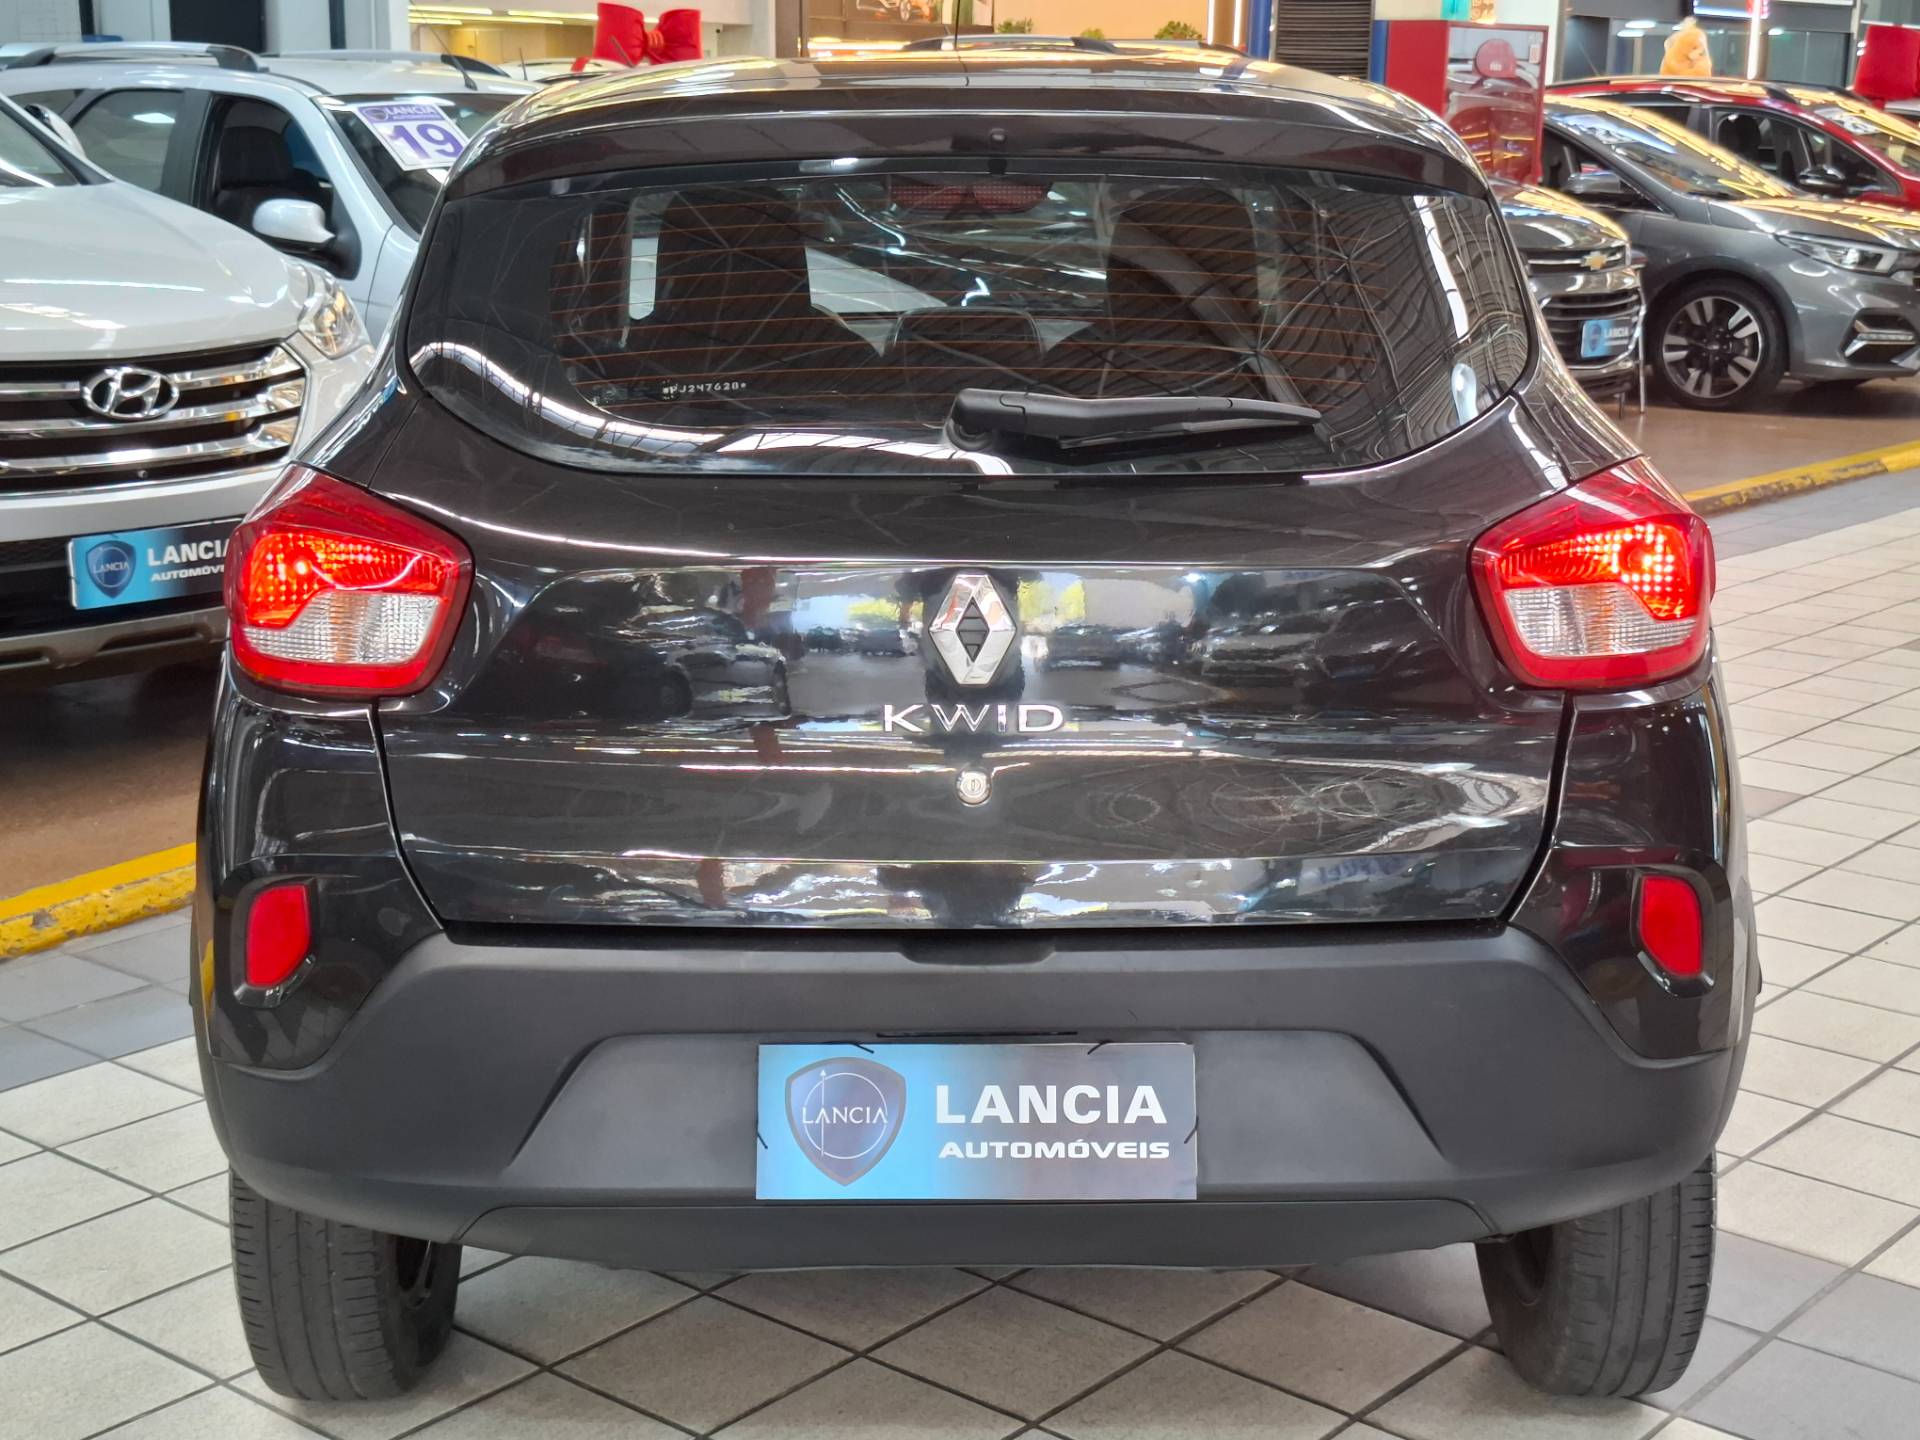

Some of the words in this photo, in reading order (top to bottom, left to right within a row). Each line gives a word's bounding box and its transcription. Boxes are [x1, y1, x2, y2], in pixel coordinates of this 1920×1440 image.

[388, 123, 464, 158] 19
[884, 704, 1063, 732] KWID
[802, 1106, 888, 1124] LANCIA
[936, 1084, 1168, 1124] LANCIA
[938, 1138, 1170, 1159] AUTOMÓVEIS
